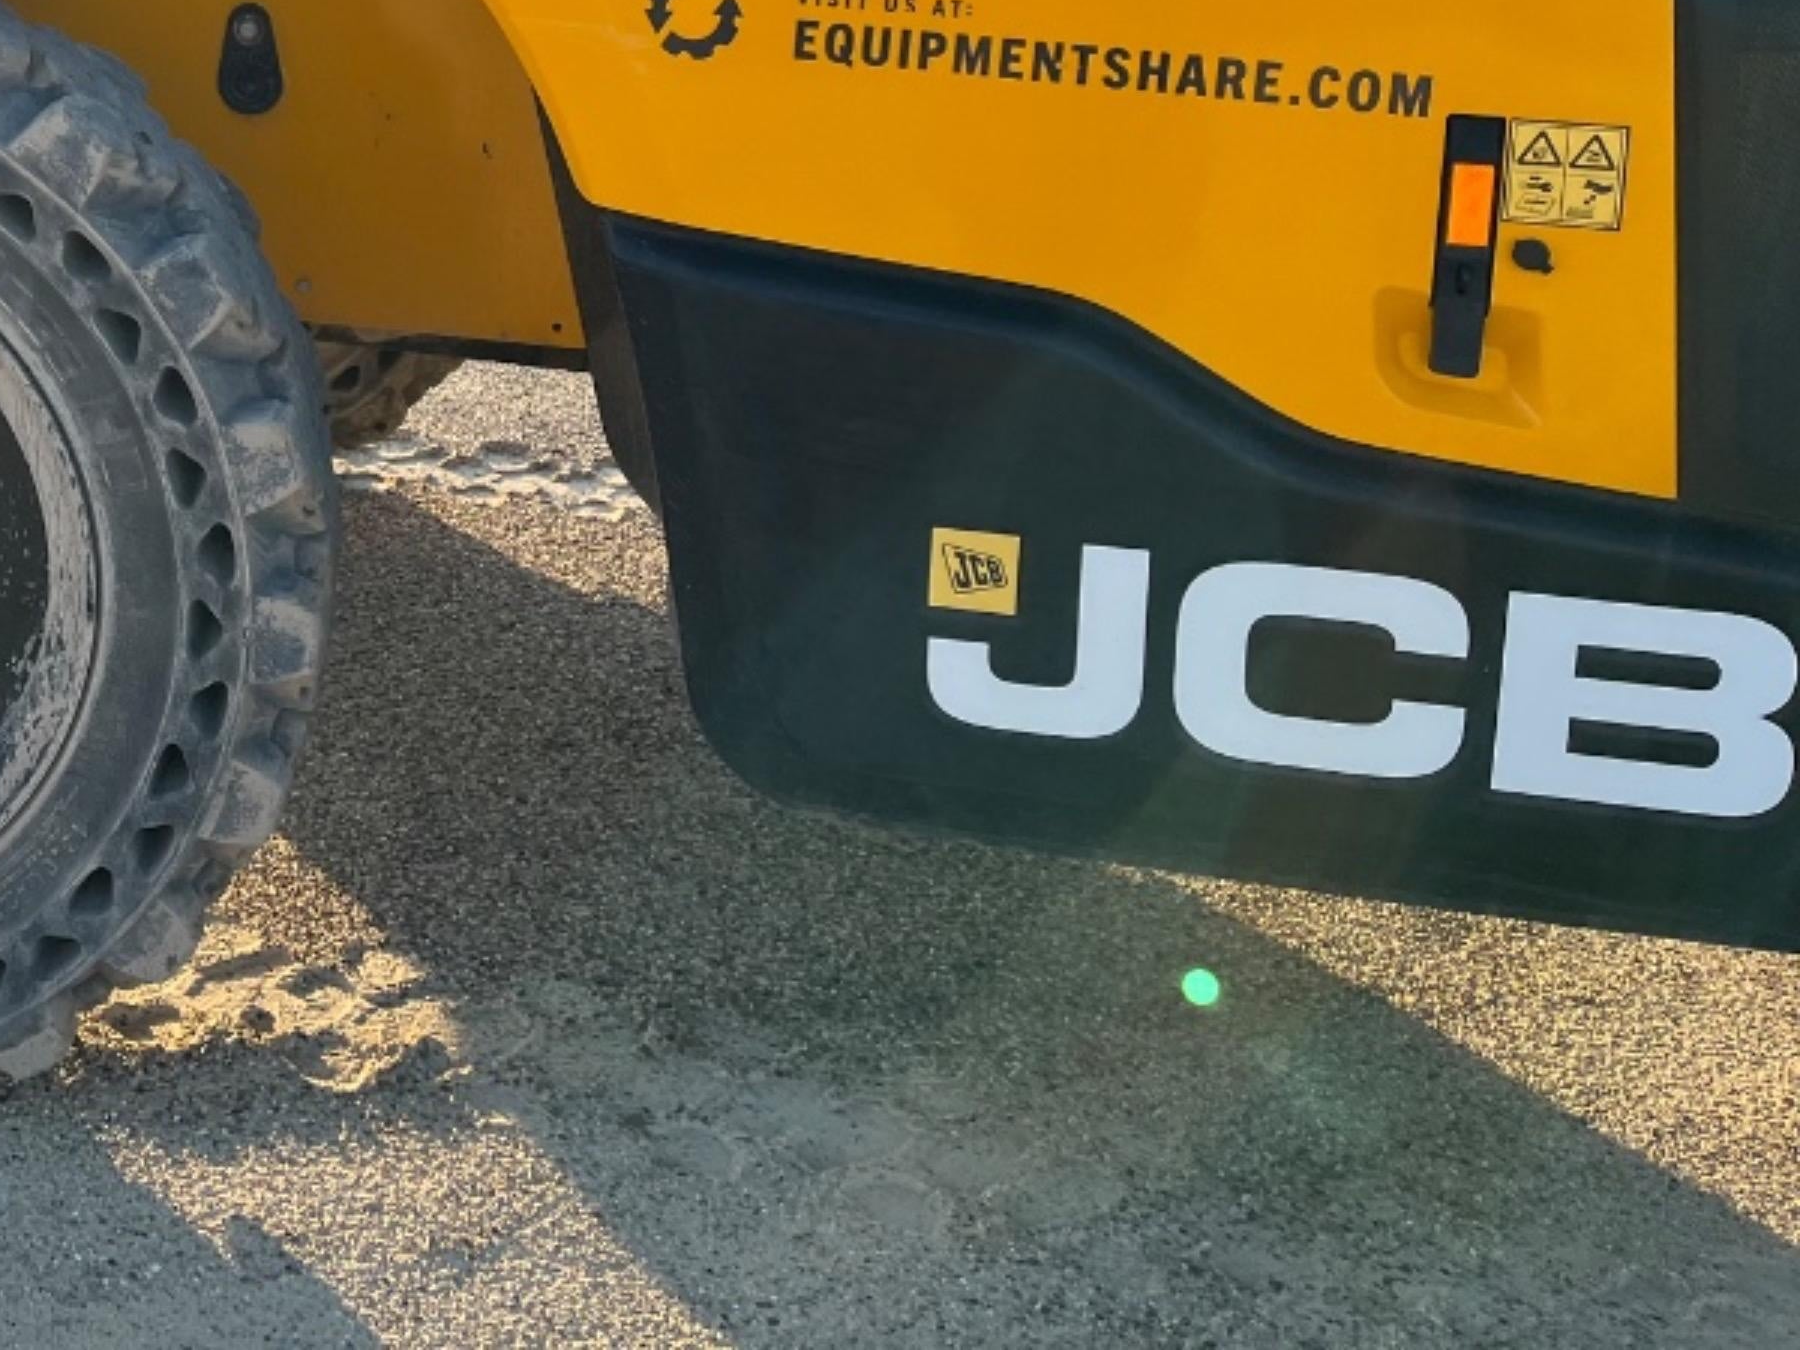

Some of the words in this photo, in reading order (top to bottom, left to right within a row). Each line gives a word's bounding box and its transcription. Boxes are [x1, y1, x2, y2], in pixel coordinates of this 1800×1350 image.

[932, 0, 974, 18] AT:
[793, 19, 1433, 118] EQUIPMENTSHARE.COM
[952, 549, 1006, 590] JCB
[926, 543, 1798, 818] JCB
